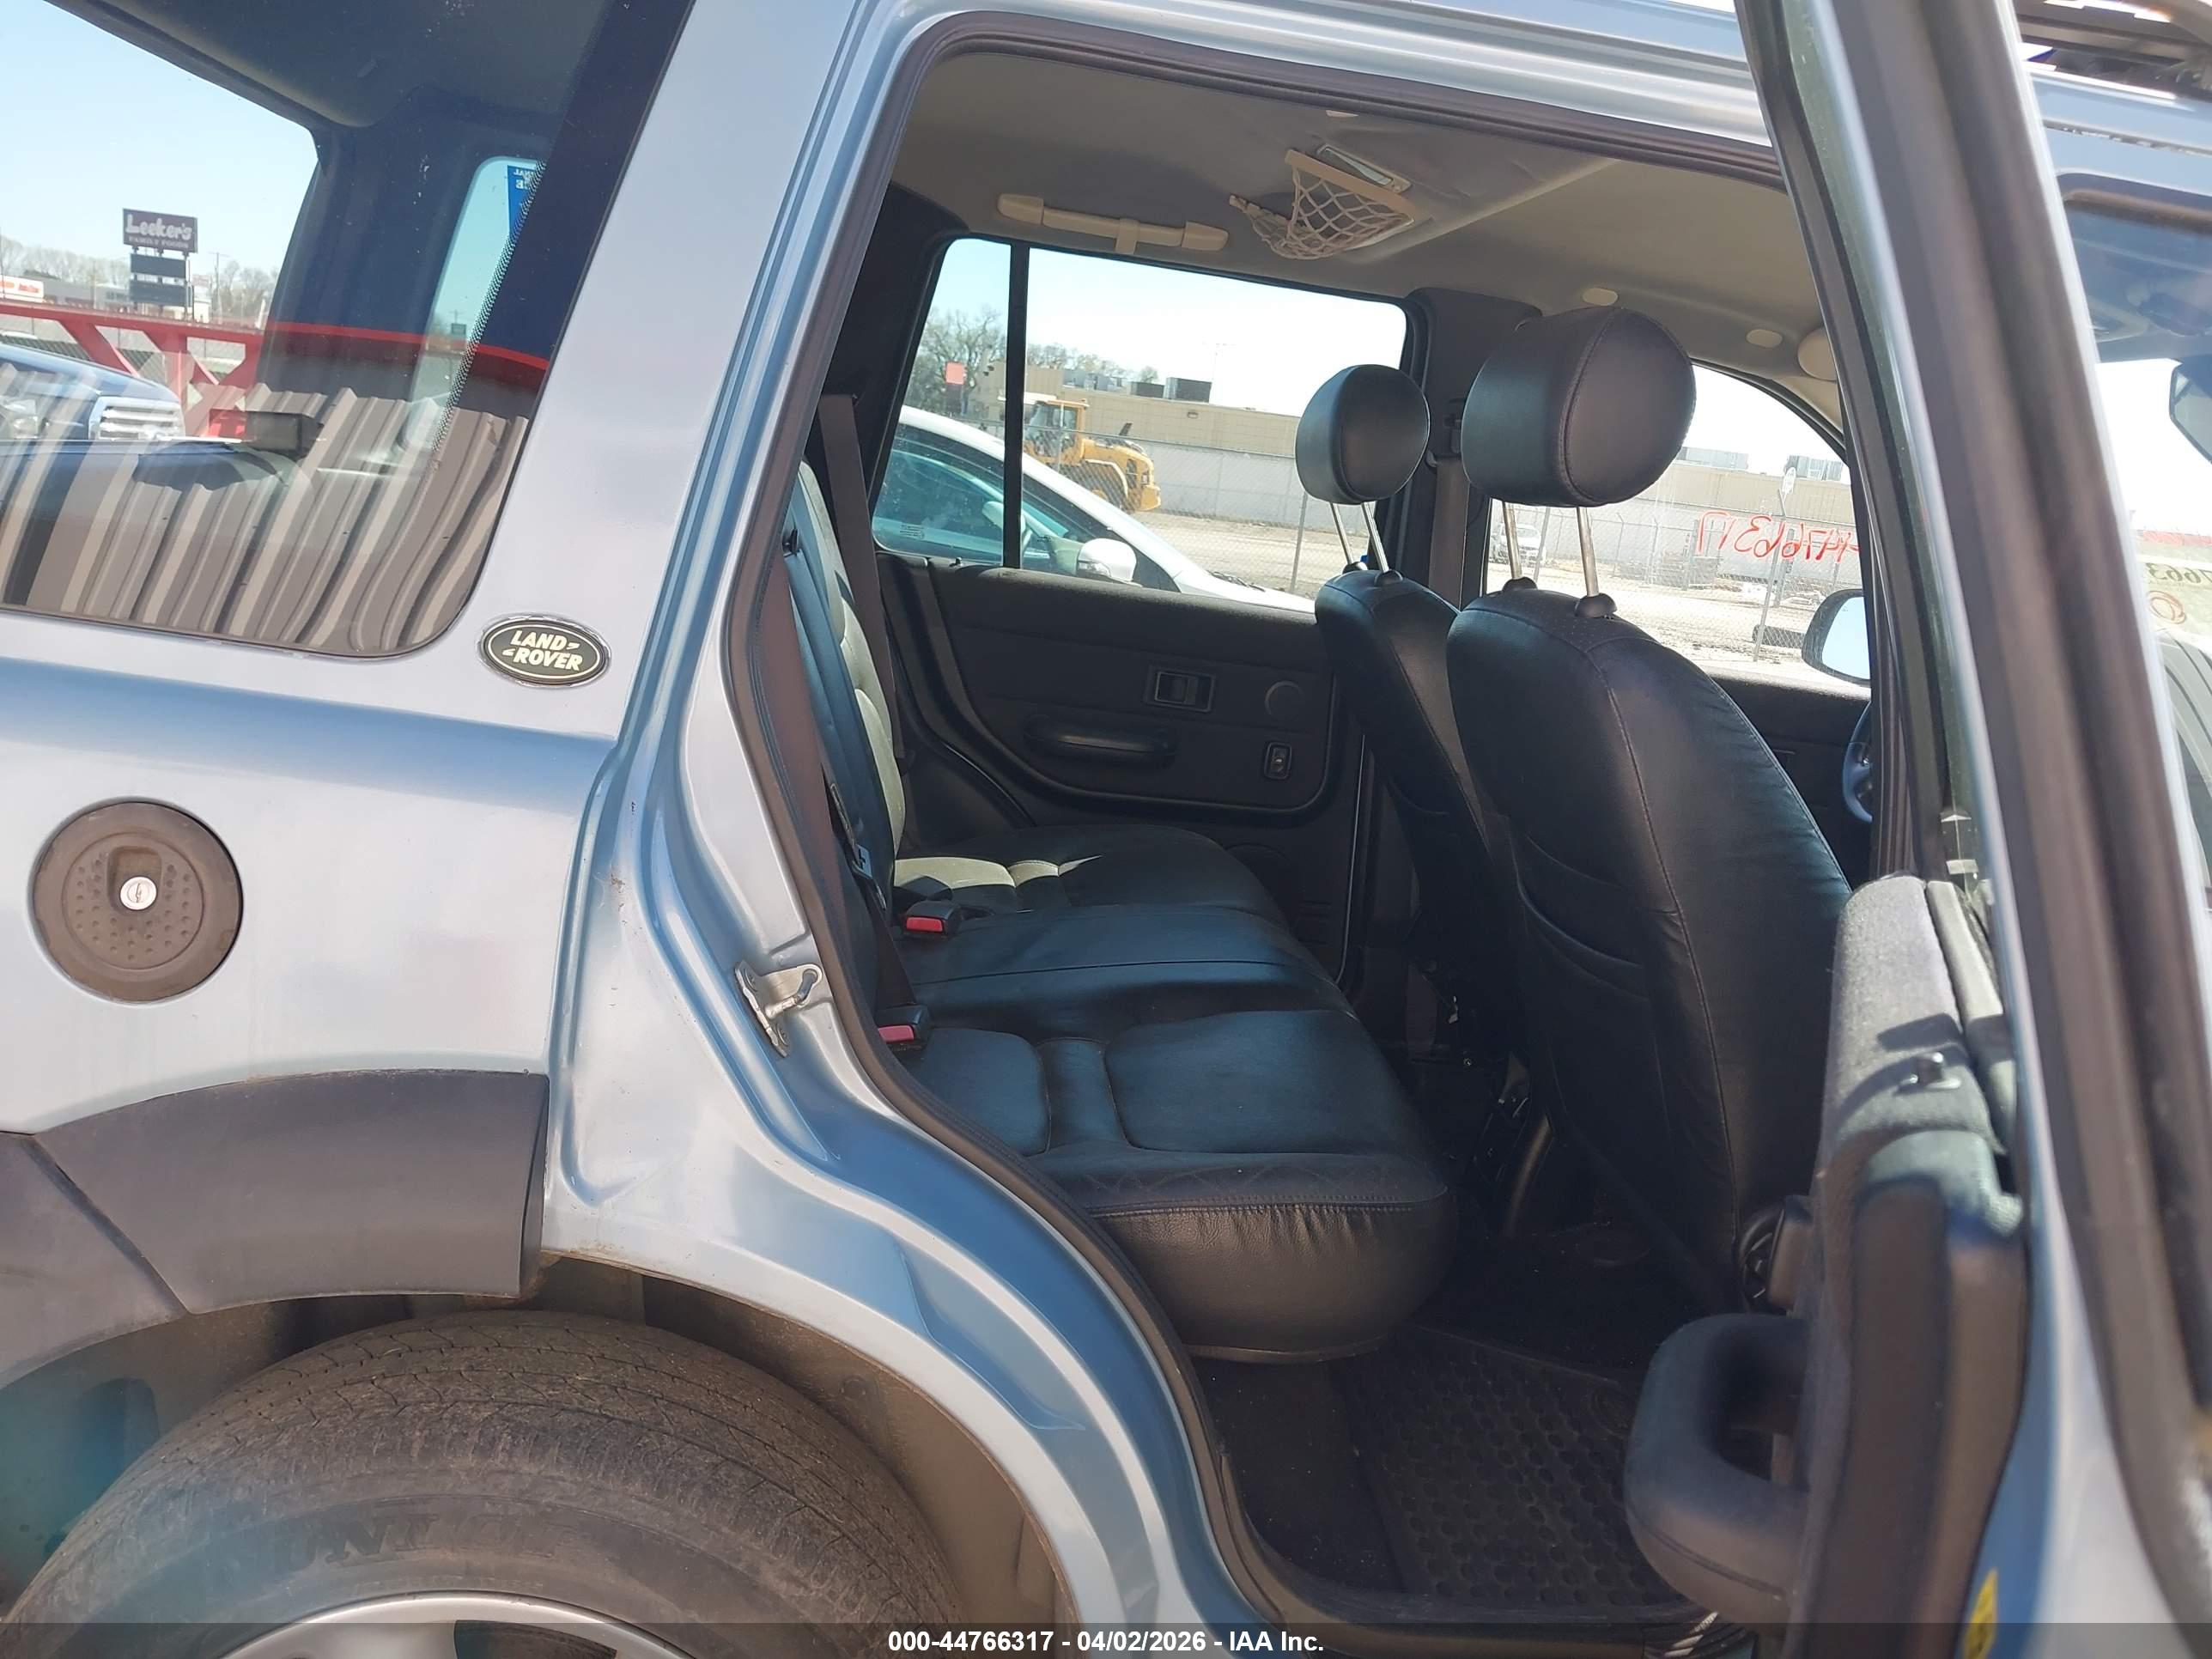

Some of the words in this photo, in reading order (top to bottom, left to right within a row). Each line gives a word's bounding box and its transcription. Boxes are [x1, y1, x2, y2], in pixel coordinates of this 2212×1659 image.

[126, 214, 193, 240] Leeker's
[510, 629, 568, 651] LAND
[513, 647, 583, 671] ROVER
